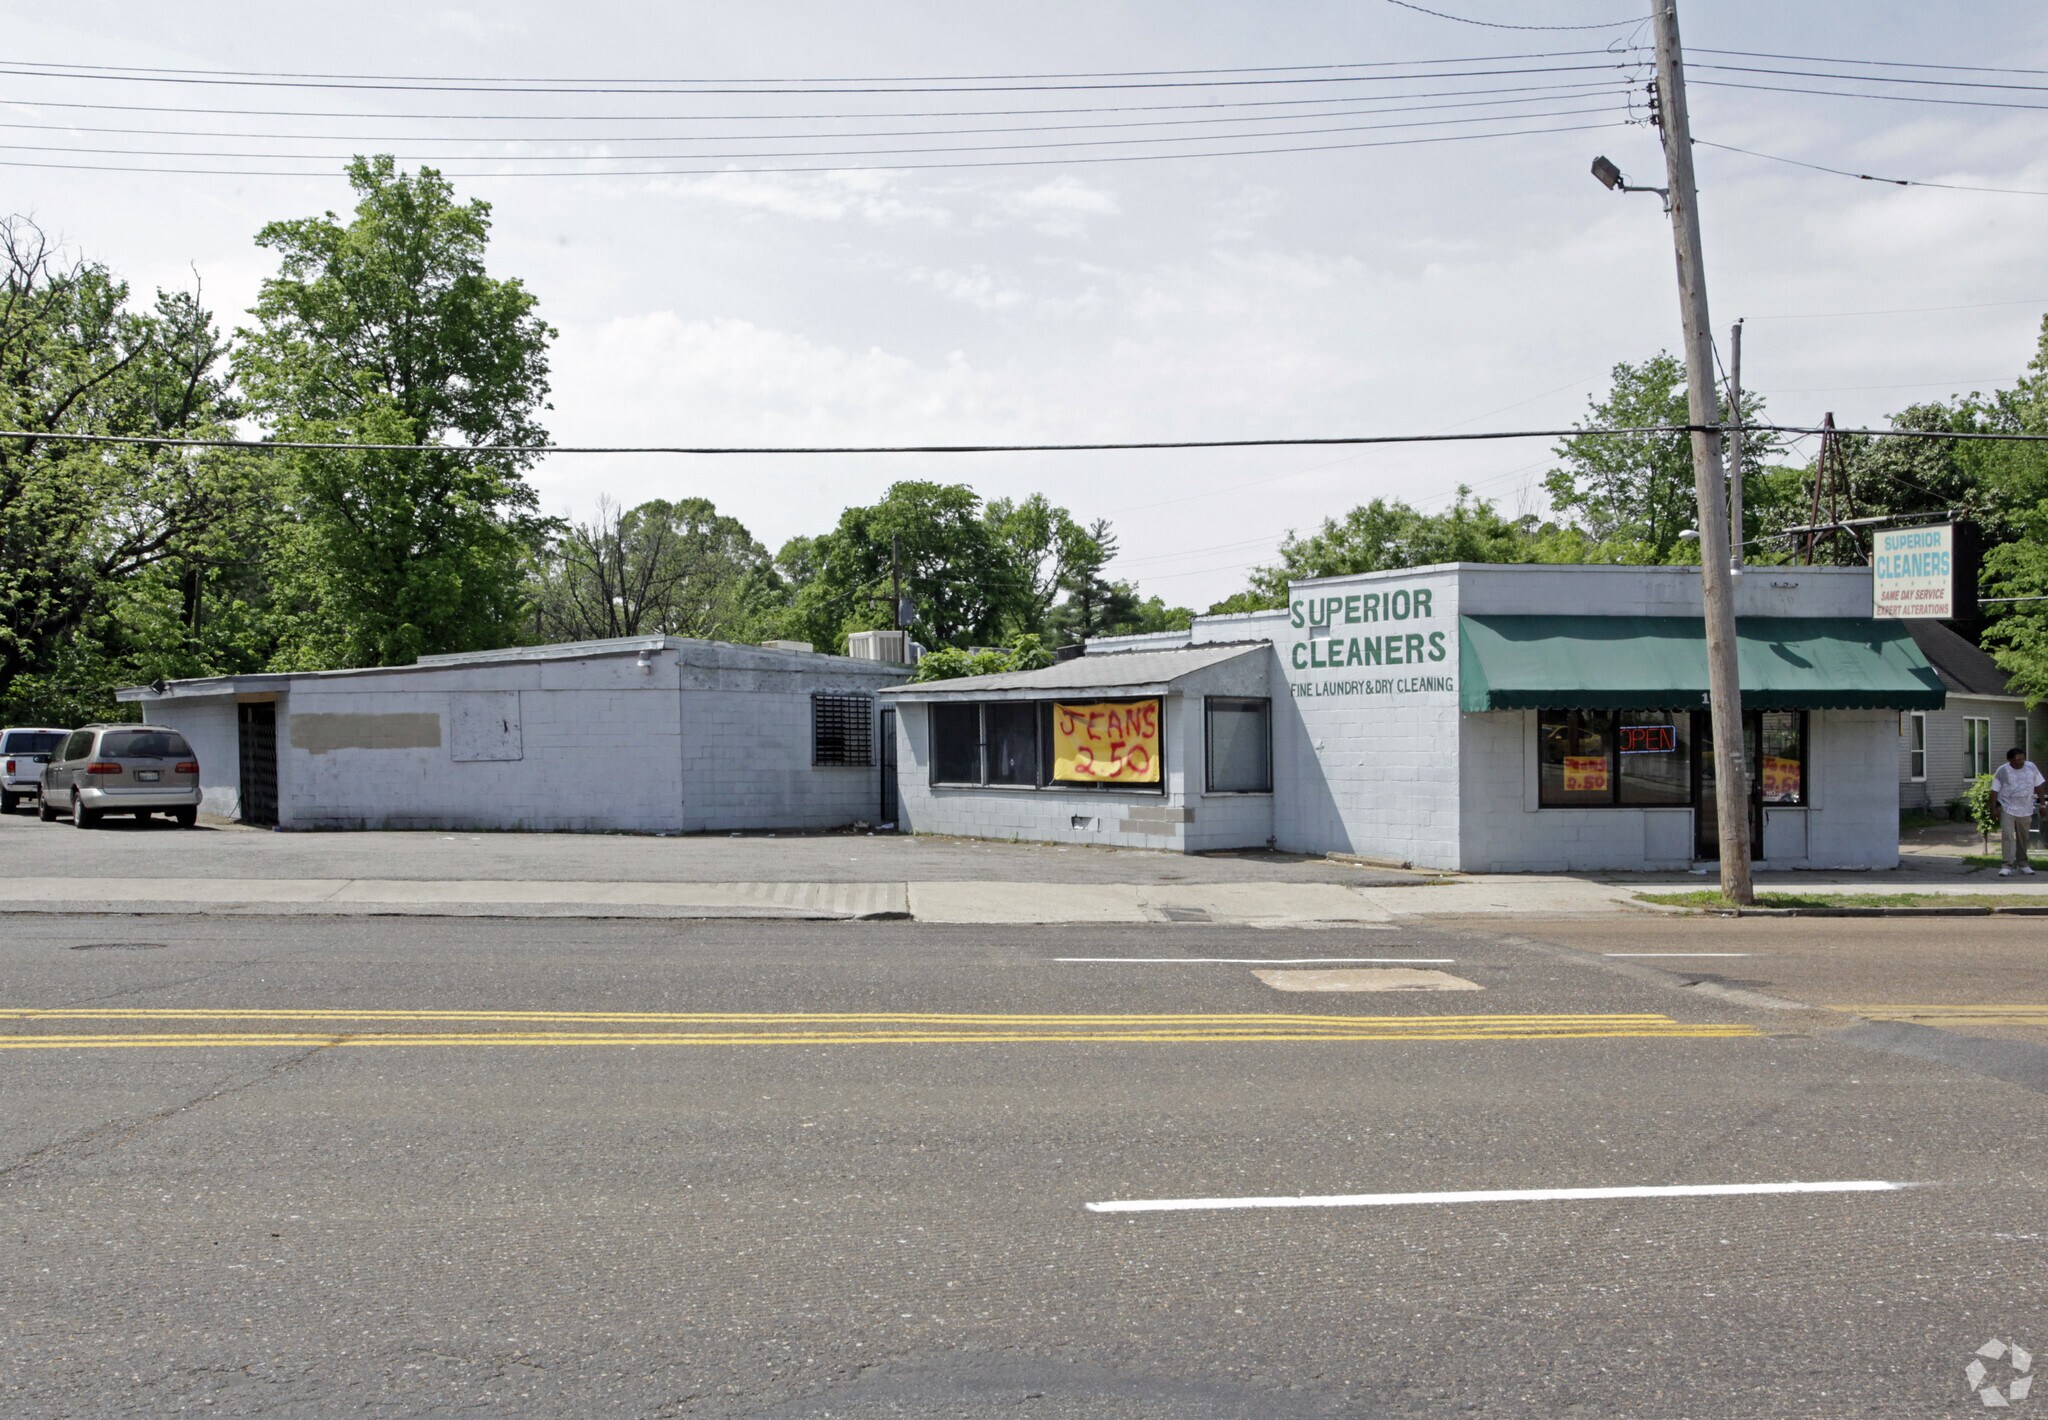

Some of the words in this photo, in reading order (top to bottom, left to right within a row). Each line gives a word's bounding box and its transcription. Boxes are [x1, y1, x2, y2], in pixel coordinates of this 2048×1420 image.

[1884, 532, 1941, 551] SUPERIOR
[1877, 551, 1950, 579] CLEANERS
[1881, 591, 1900, 601] SAME
[1901, 590, 1915, 600] DAY
[1915, 588, 1945, 599] SERVICE
[1291, 588, 1433, 629] SUPERIOR
[1877, 605, 1902, 616] EXPERT
[1903, 603, 1949, 615] ALTERATIONS
[1292, 631, 1446, 669] CLEANERS
[1291, 682, 1313, 697] FINE
[1397, 677, 1453, 693] CLEANING
[1060, 704, 1156, 740] JEANS
[1620, 728, 1673, 751] OPEN
[1567, 775, 1605, 790] 2.50
